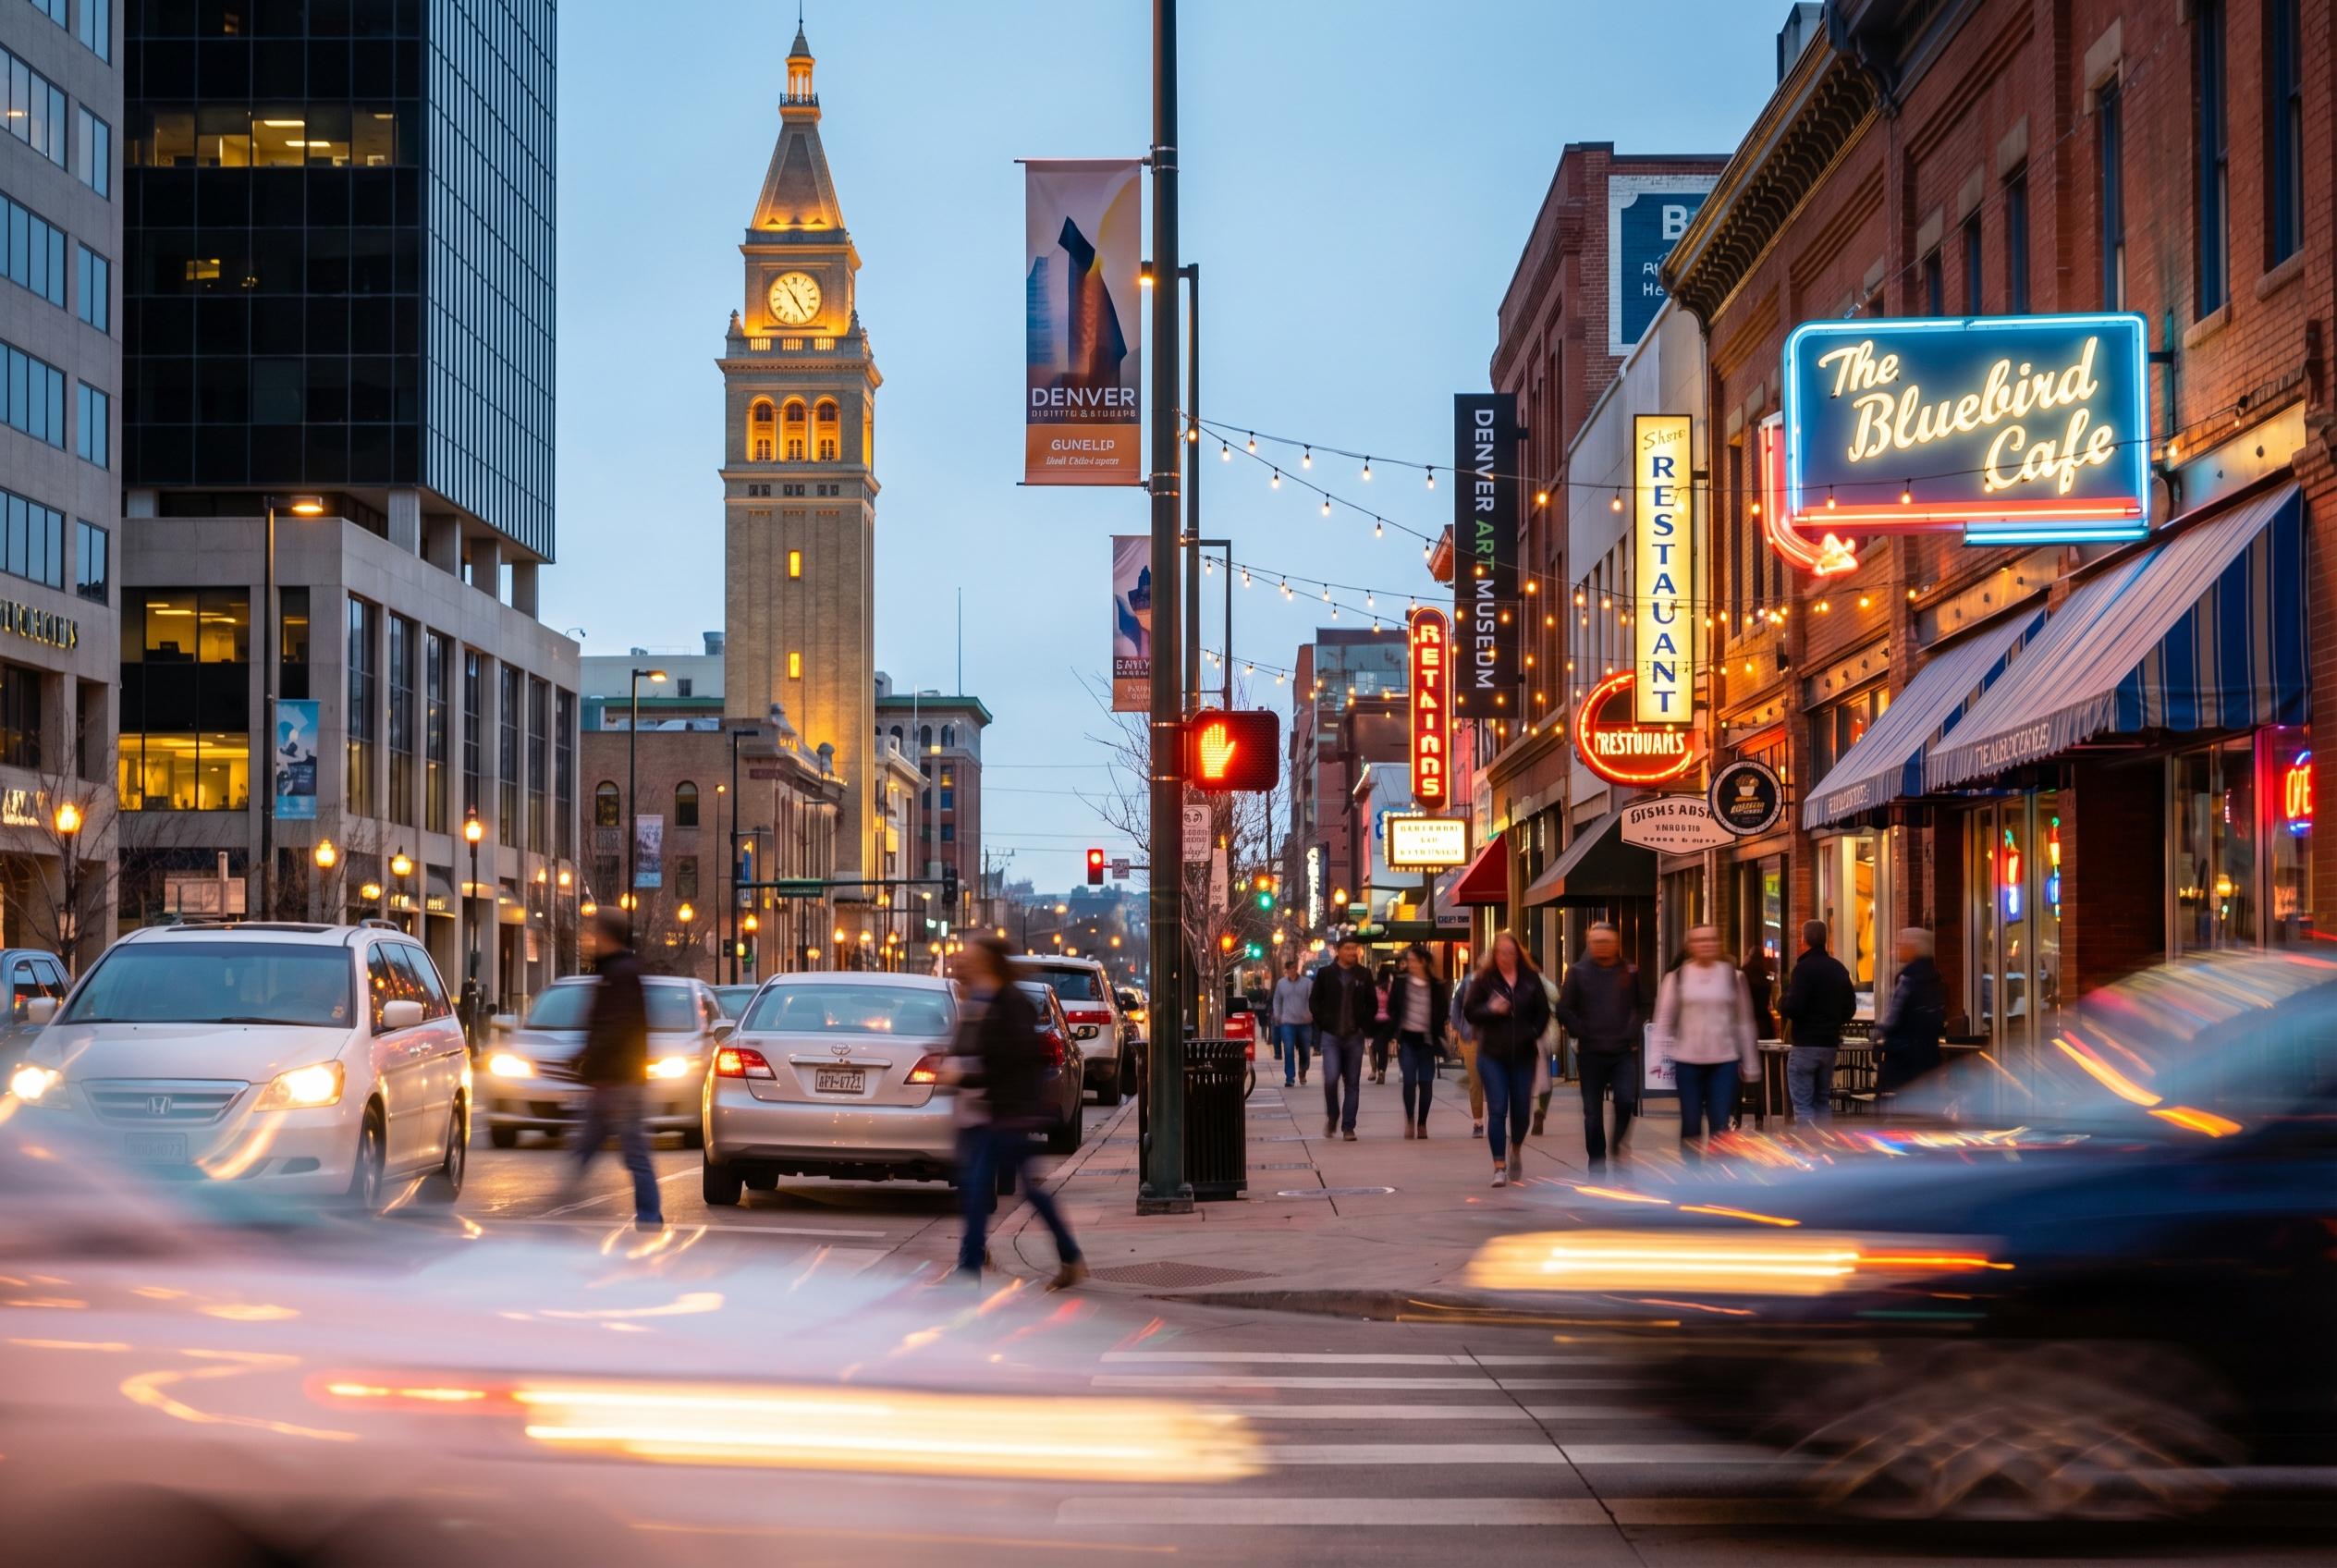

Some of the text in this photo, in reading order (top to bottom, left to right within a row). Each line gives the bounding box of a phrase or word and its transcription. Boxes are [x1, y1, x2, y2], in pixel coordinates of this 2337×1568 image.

[1662, 205, 1692, 239] B
[1032, 387, 1135, 407] DENVER
[1818, 340, 1900, 398] The
[1848, 337, 2098, 462] Bluebird
[1475, 410, 1494, 511] DENVER
[1984, 408, 2115, 496] Cafe
[1475, 520, 1495, 570] ART
[1652, 456, 1677, 713] RESTAUANT
